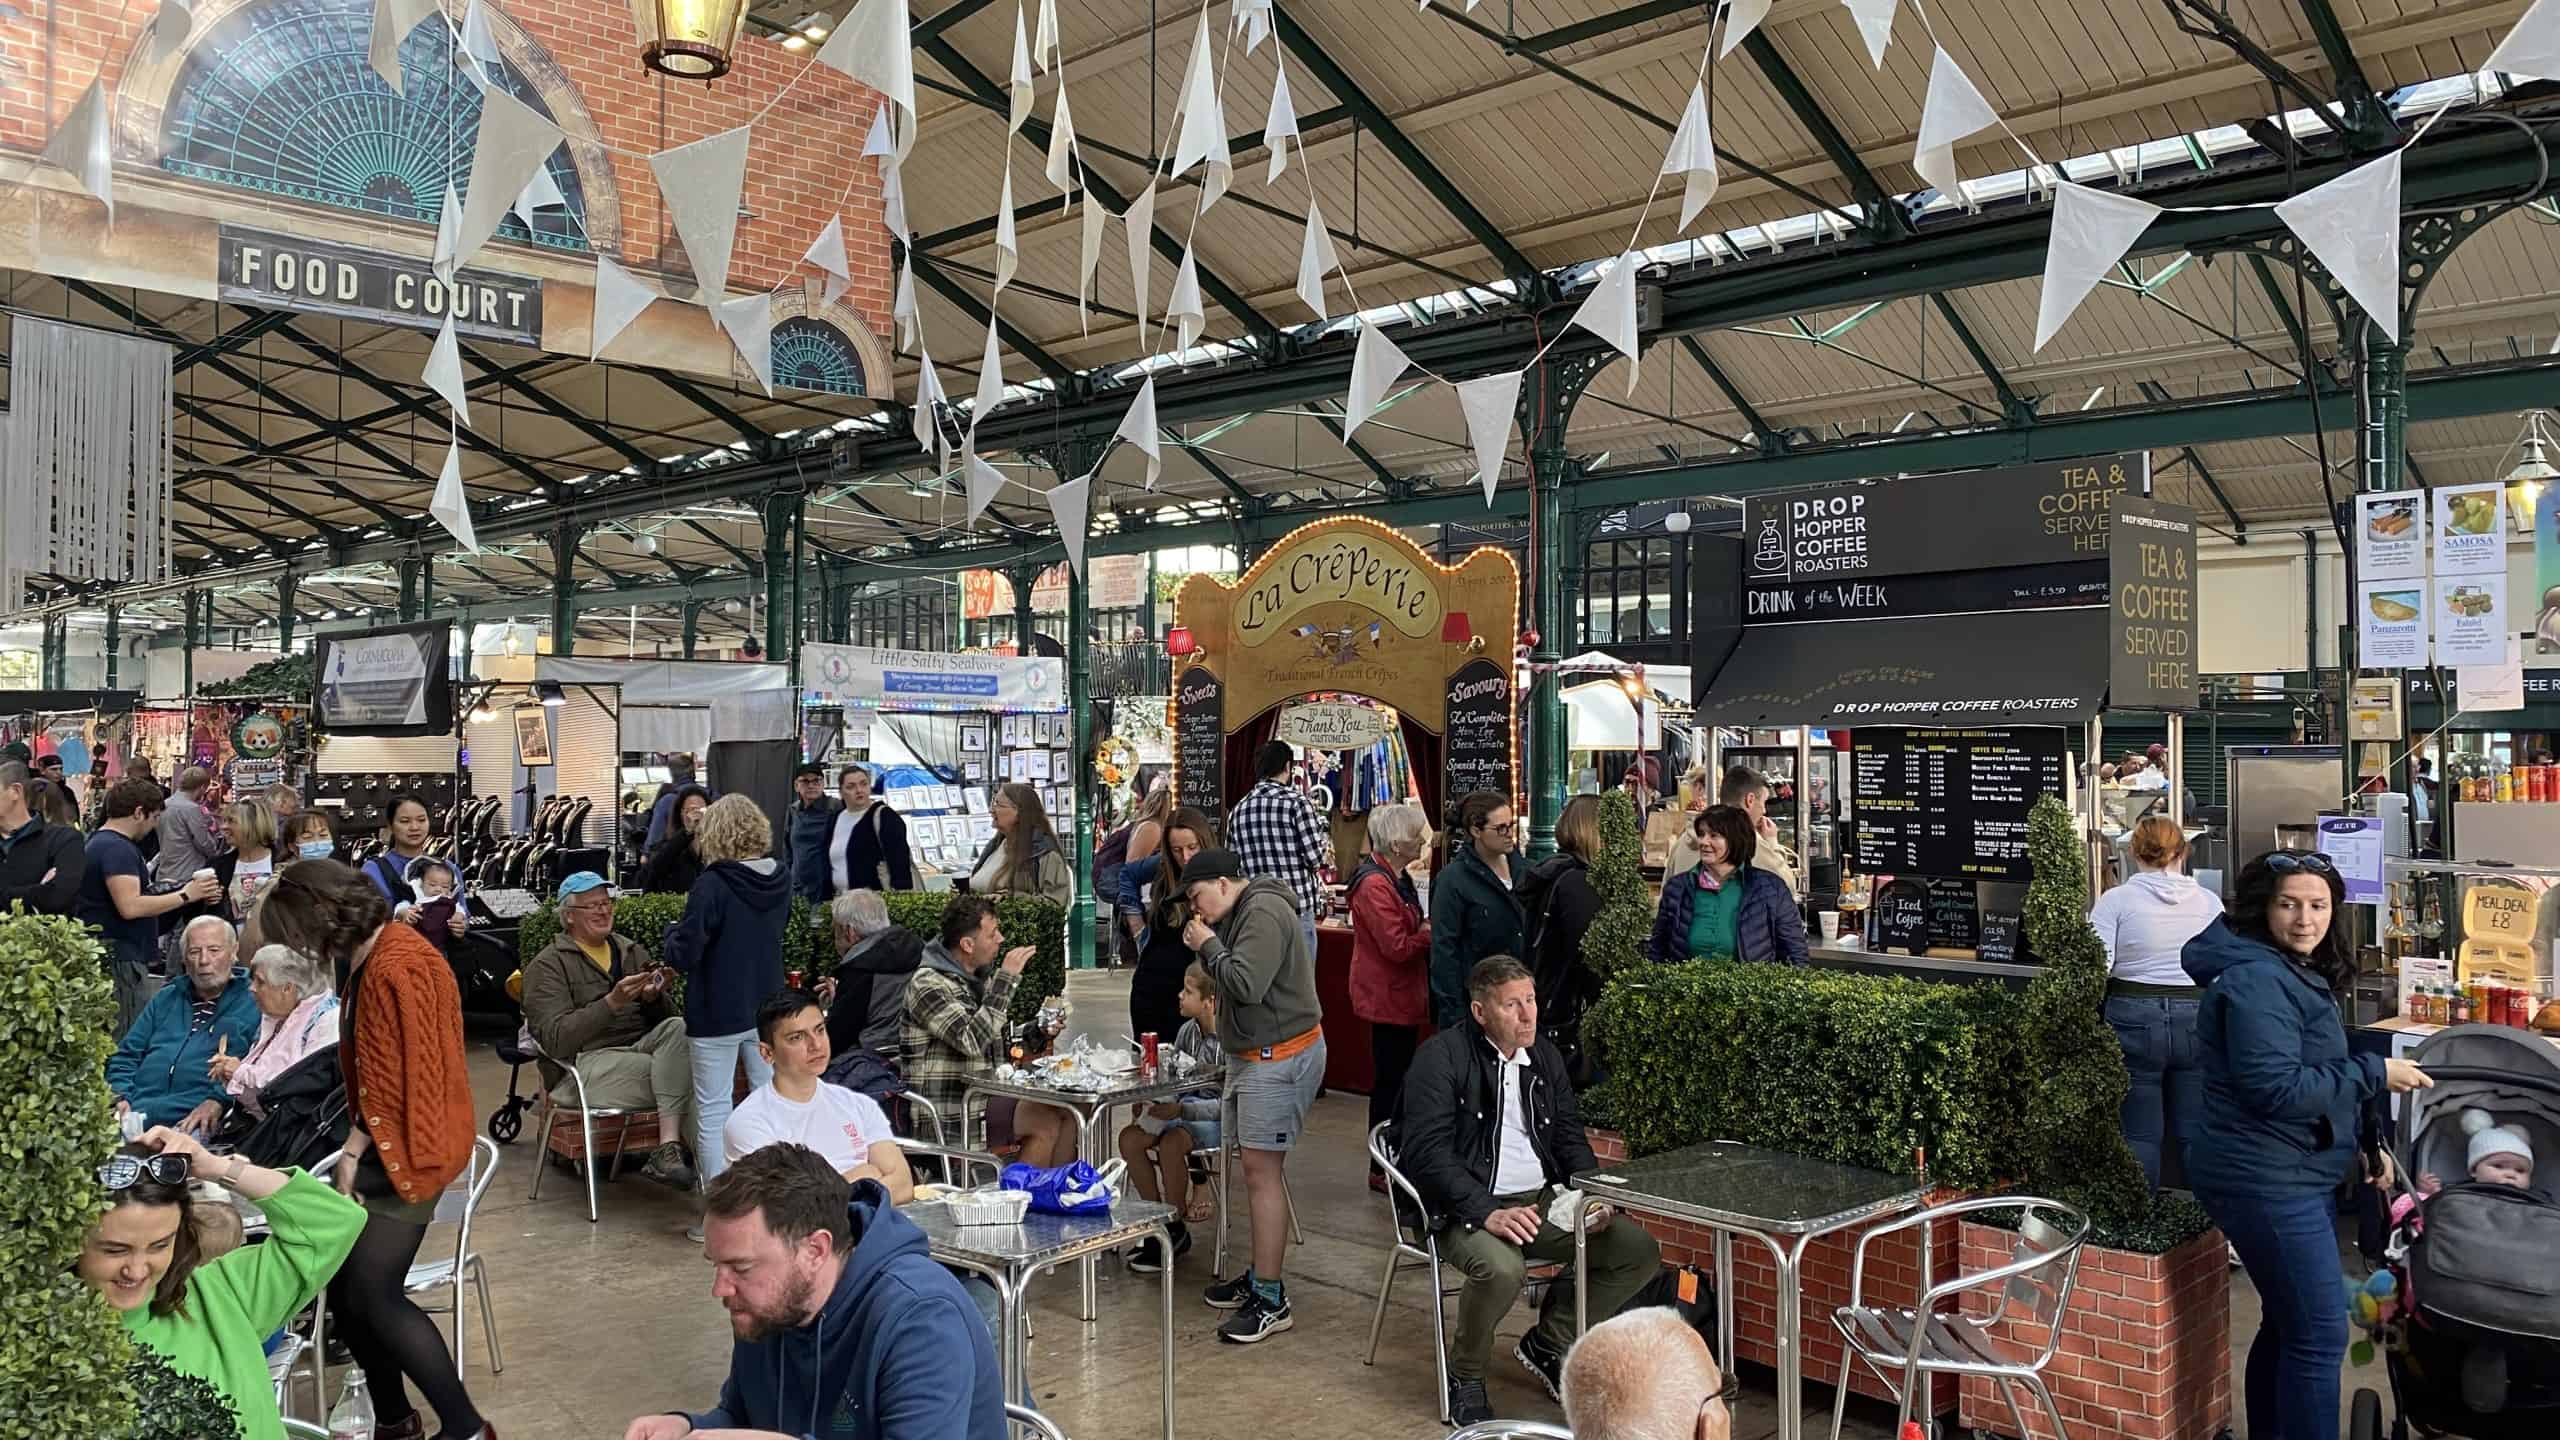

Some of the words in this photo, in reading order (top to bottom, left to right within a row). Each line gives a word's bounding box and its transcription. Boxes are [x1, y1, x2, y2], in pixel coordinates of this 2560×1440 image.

[241, 247, 358, 300] FOOD
[394, 273, 525, 327] COURT
[2061, 466, 2101, 489] TEA
[2108, 463, 2127, 484] &
[1794, 495, 1865, 519] DROP
[2039, 488, 2128, 515] COFFE
[1794, 517, 1866, 538] HOPPER
[2044, 513, 2111, 535] SERVE
[1795, 535, 1868, 557] COFFEE
[2074, 534, 2111, 551] HE
[2445, 536, 2494, 547] SAMOSA
[1795, 555, 1868, 573] ROASTERS
[2139, 543, 2169, 579] TEA
[2174, 547, 2188, 581] &
[1241, 583, 1284, 630] La
[1291, 543, 1426, 618] Crêperie
[1748, 590, 1796, 615] DRINK
[1804, 589, 1816, 609] of
[1818, 589, 1835, 604] the
[1837, 583, 1888, 608] WEEK
[2121, 583, 2189, 621] COFFEE
[2126, 626, 2188, 656] SERVED
[871, 647, 907, 665] Little
[911, 652, 944, 672] Salty
[950, 655, 1007, 671] Seahorse
[2148, 662, 2189, 689] HERE
[1447, 678, 1508, 703] Savoury
[1320, 708, 1333, 716] ALL
[1833, 703, 1882, 714] DROP
[1883, 702, 1941, 713] HOPPER
[1942, 700, 2001, 712] COFFEE
[2002, 698, 2079, 710] ROASTERS
[1295, 716, 1338, 733] Thank
[1338, 716, 1363, 733] You
[1310, 734, 1352, 743] CUSTOMERS
[1897, 899, 1922, 911] Iced
[2476, 896, 2503, 911] MEAL
[2503, 898, 2529, 913] DEAL
[1896, 912, 1924, 930] Coffee
[2491, 911, 2511, 929] £8
